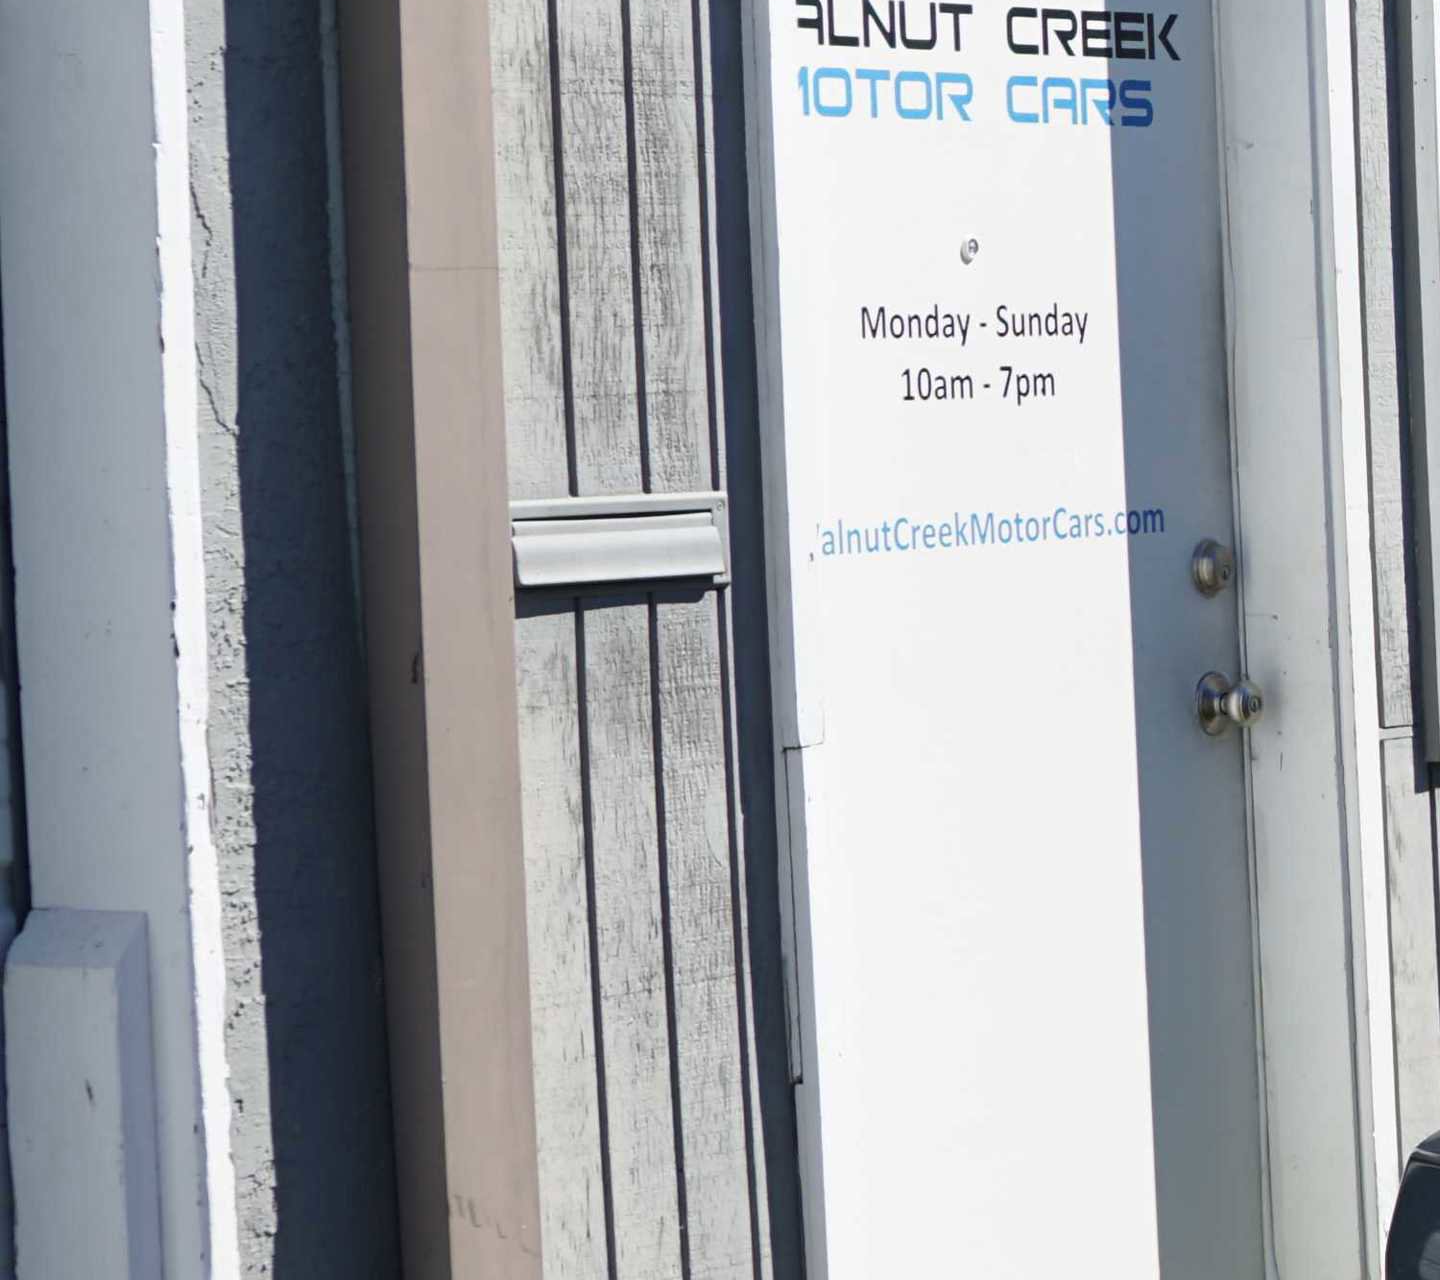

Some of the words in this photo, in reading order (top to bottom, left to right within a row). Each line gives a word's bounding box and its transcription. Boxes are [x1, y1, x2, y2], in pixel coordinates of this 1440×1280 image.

[1006, 6, 1182, 61] CREEK
[1005, 75, 1154, 128] CARS
[860, 303, 971, 347] Monday
[996, 302, 1088, 345] Sunday
[900, 367, 974, 401] 10am
[999, 366, 1055, 407] 7pm
[815, 506, 1165, 556] alnutCreekMotorCars.com
